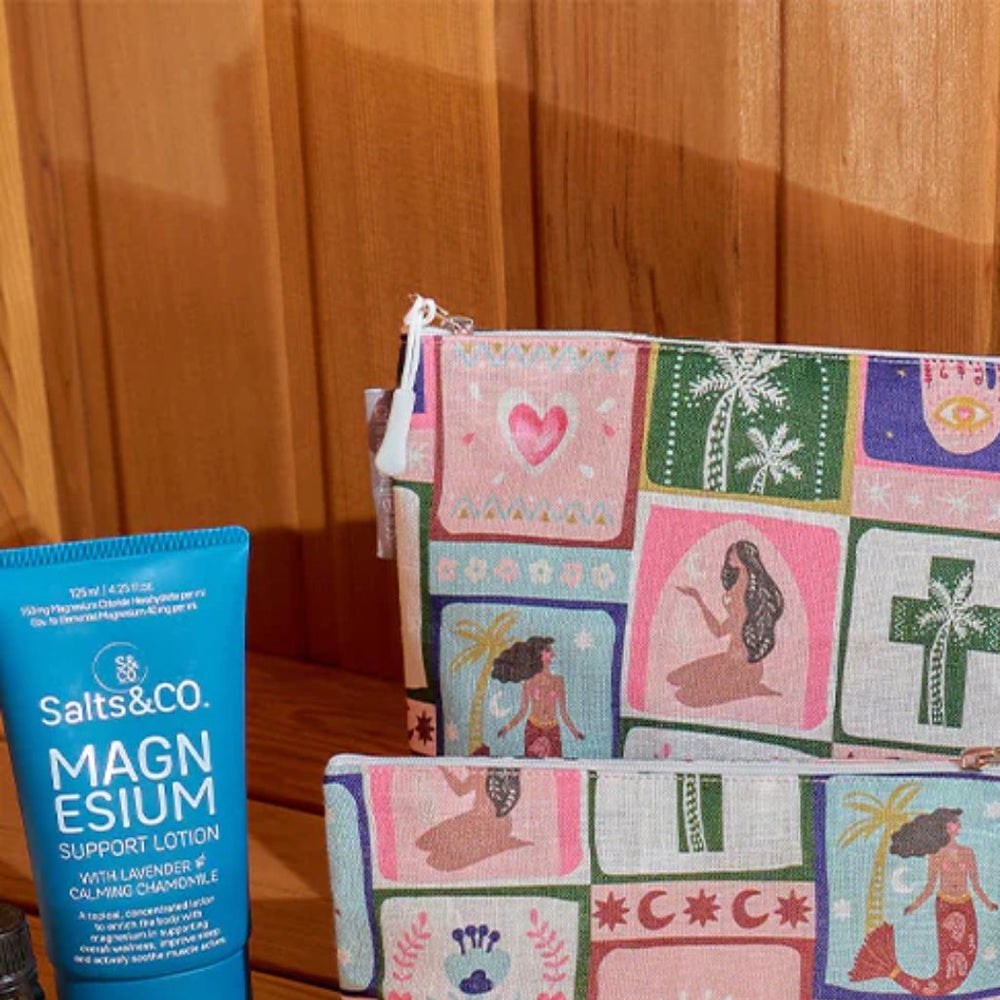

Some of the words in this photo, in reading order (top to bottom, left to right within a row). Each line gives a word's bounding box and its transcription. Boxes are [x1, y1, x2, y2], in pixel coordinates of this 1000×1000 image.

[48, 730, 213, 790] MAGN
[54, 776, 217, 834] ESIUM
[59, 835, 148, 860] SUPPORT
[153, 824, 220, 851] LOTION
[69, 883, 132, 900] CALMING
[136, 868, 219, 896] CHAMOMILE
[79, 869, 116, 884] WITH
[120, 859, 191, 882] LAVENDER
